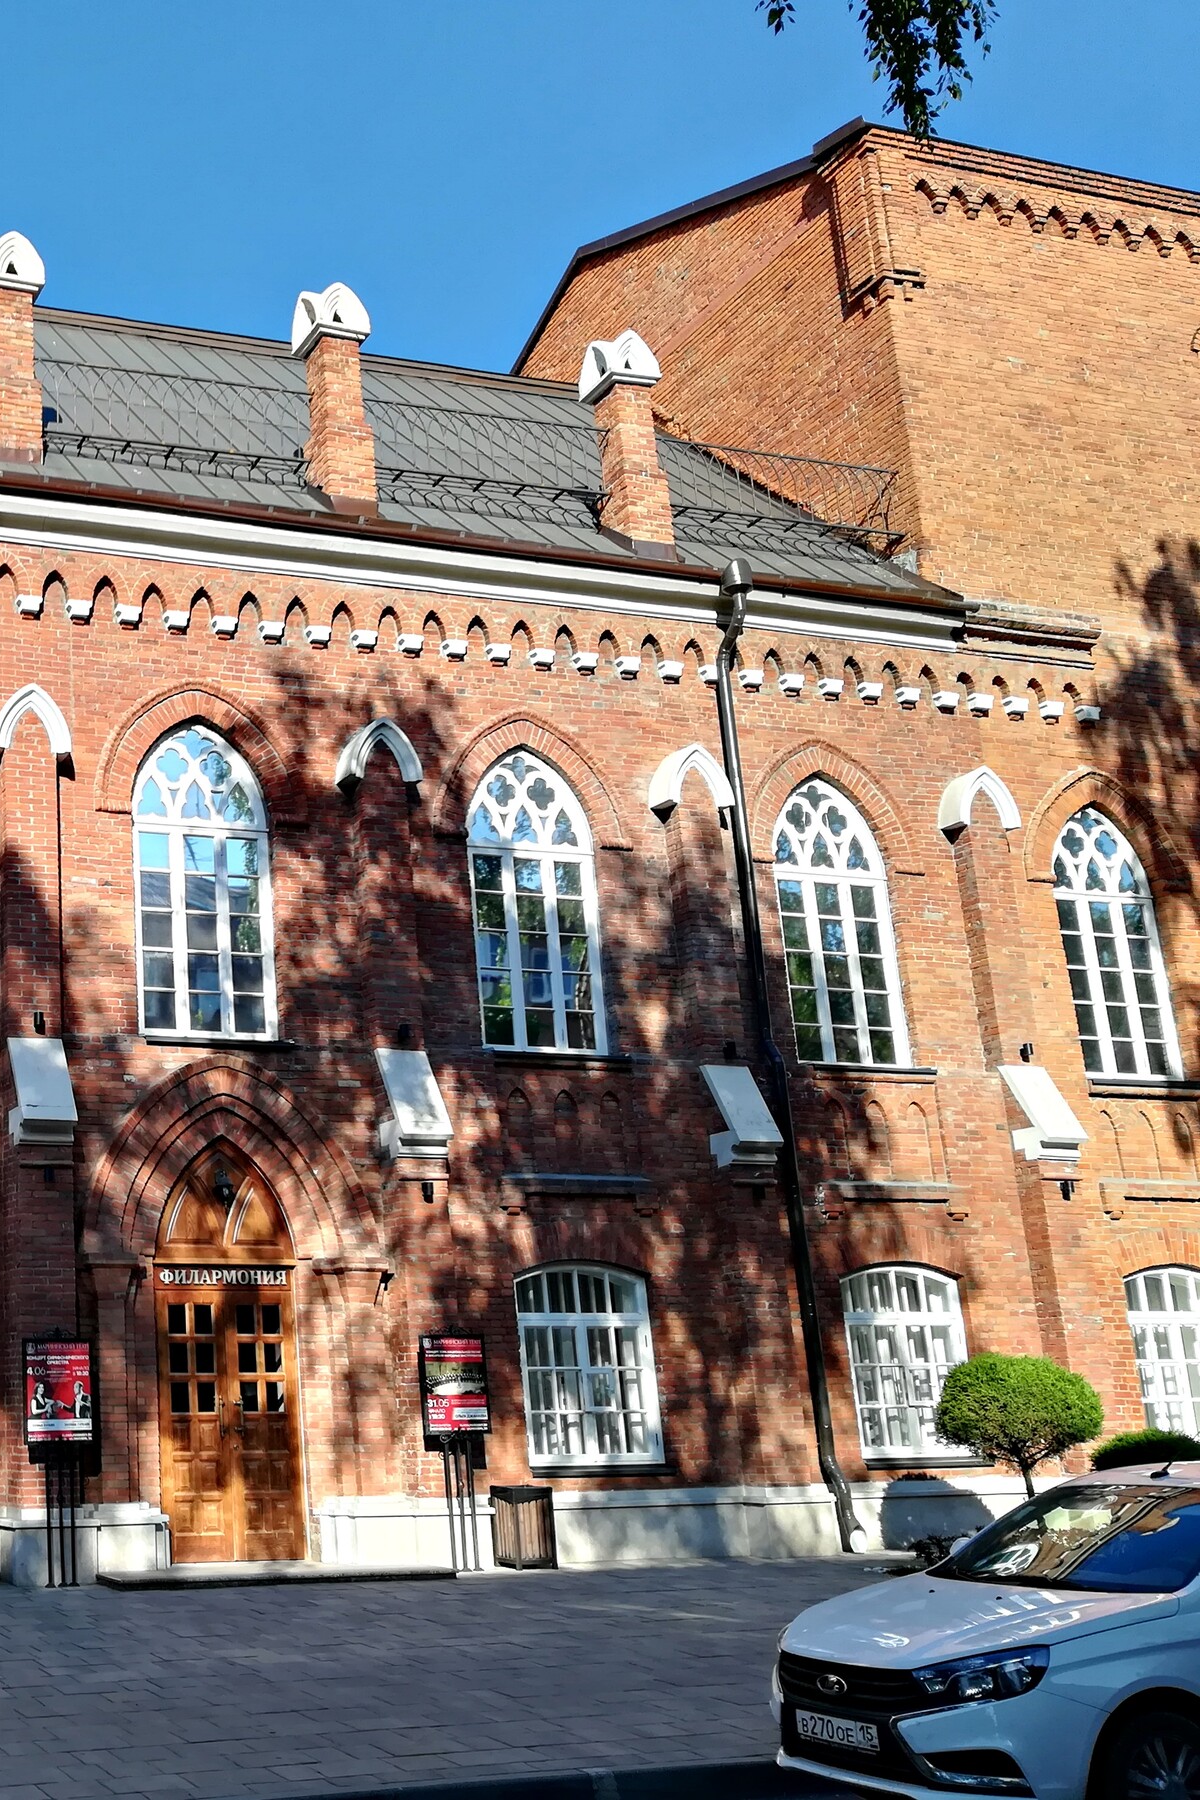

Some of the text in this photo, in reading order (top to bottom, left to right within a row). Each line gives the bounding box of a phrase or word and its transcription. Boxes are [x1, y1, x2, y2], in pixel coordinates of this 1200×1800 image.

[159, 1268, 288, 1285] ФИЛАРМОНИЯ
[26, 1366, 46, 1376] 4.06
[427, 1399, 450, 1408] 31.05
